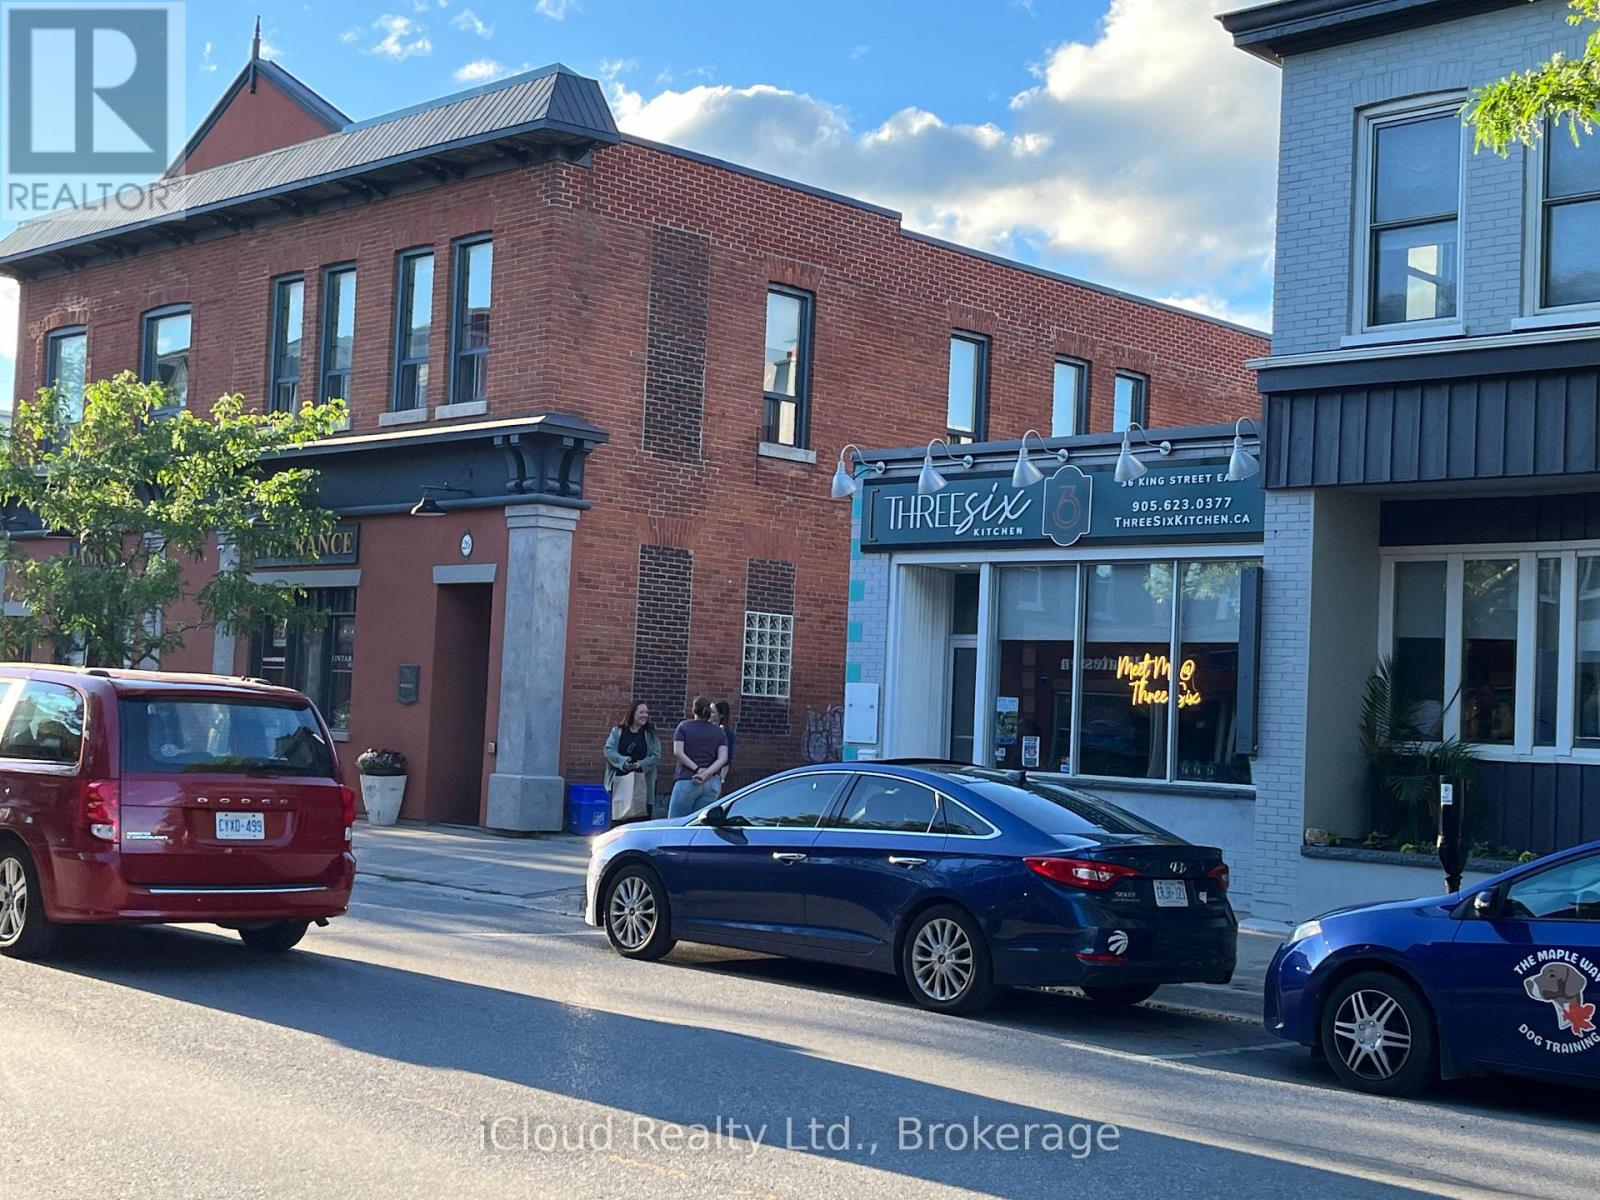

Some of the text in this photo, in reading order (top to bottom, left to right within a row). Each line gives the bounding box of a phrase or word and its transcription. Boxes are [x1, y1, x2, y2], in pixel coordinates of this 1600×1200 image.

[1138, 477, 1165, 487] KING
[1169, 473, 1212, 485] STREET
[1132, 496, 1232, 512] 905.623.0377
[973, 525, 1023, 537] KITCHEN
[1116, 652, 1156, 681] Meet
[1128, 677, 1169, 706] Three
[1514, 955, 1537, 975] THE
[1537, 948, 1580, 964] MAPLE
[1517, 1023, 1600, 1054] DOG TRAINING
